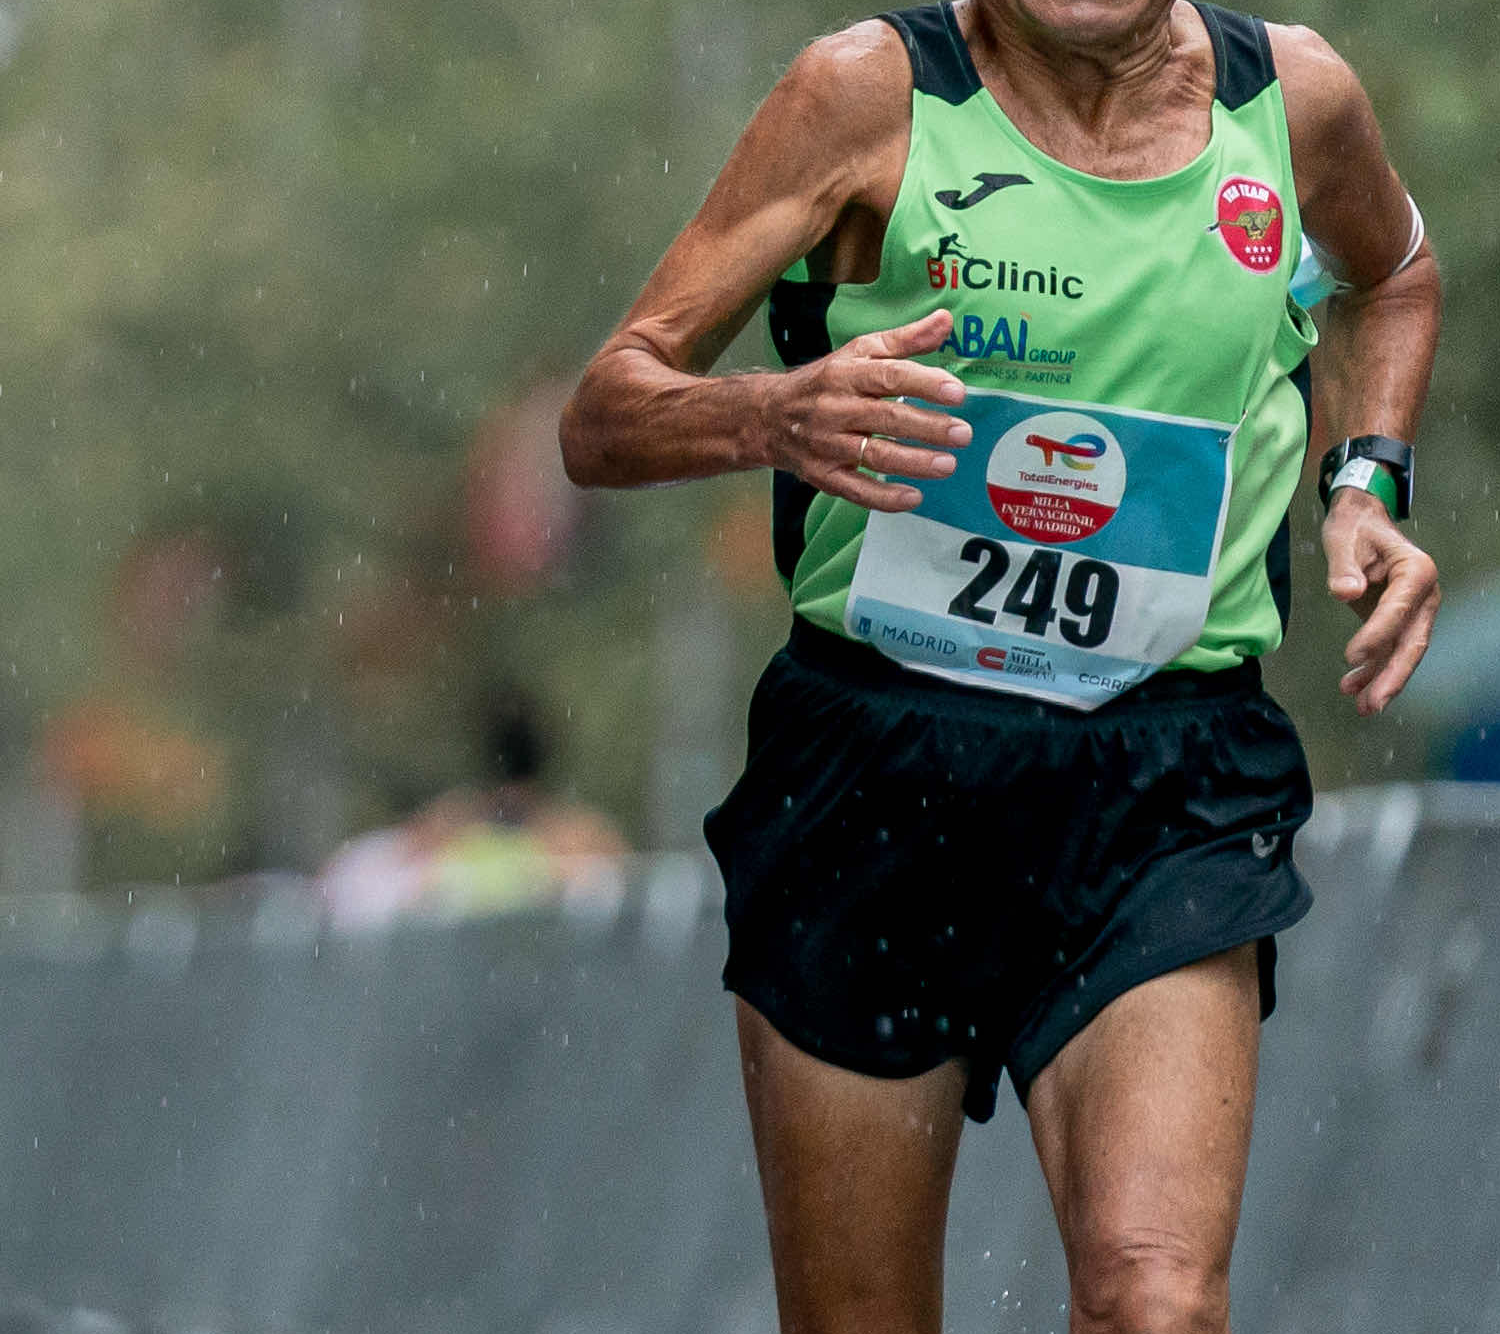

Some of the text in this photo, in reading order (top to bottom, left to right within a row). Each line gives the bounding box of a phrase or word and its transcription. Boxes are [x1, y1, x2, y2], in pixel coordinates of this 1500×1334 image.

[926, 257, 1084, 299] BiClinic
[1029, 349, 1077, 365] GROUP
[1024, 371, 1072, 385] PARTNER
[1018, 471, 1099, 492] TotalEnergies
[1032, 495, 1071, 511] MILLA
[1001, 503, 1096, 528] INTERNACIONAL
[1013, 516, 1081, 536] DE MADRID
[947, 537, 1121, 649] 249
[881, 624, 957, 655] MADRID
